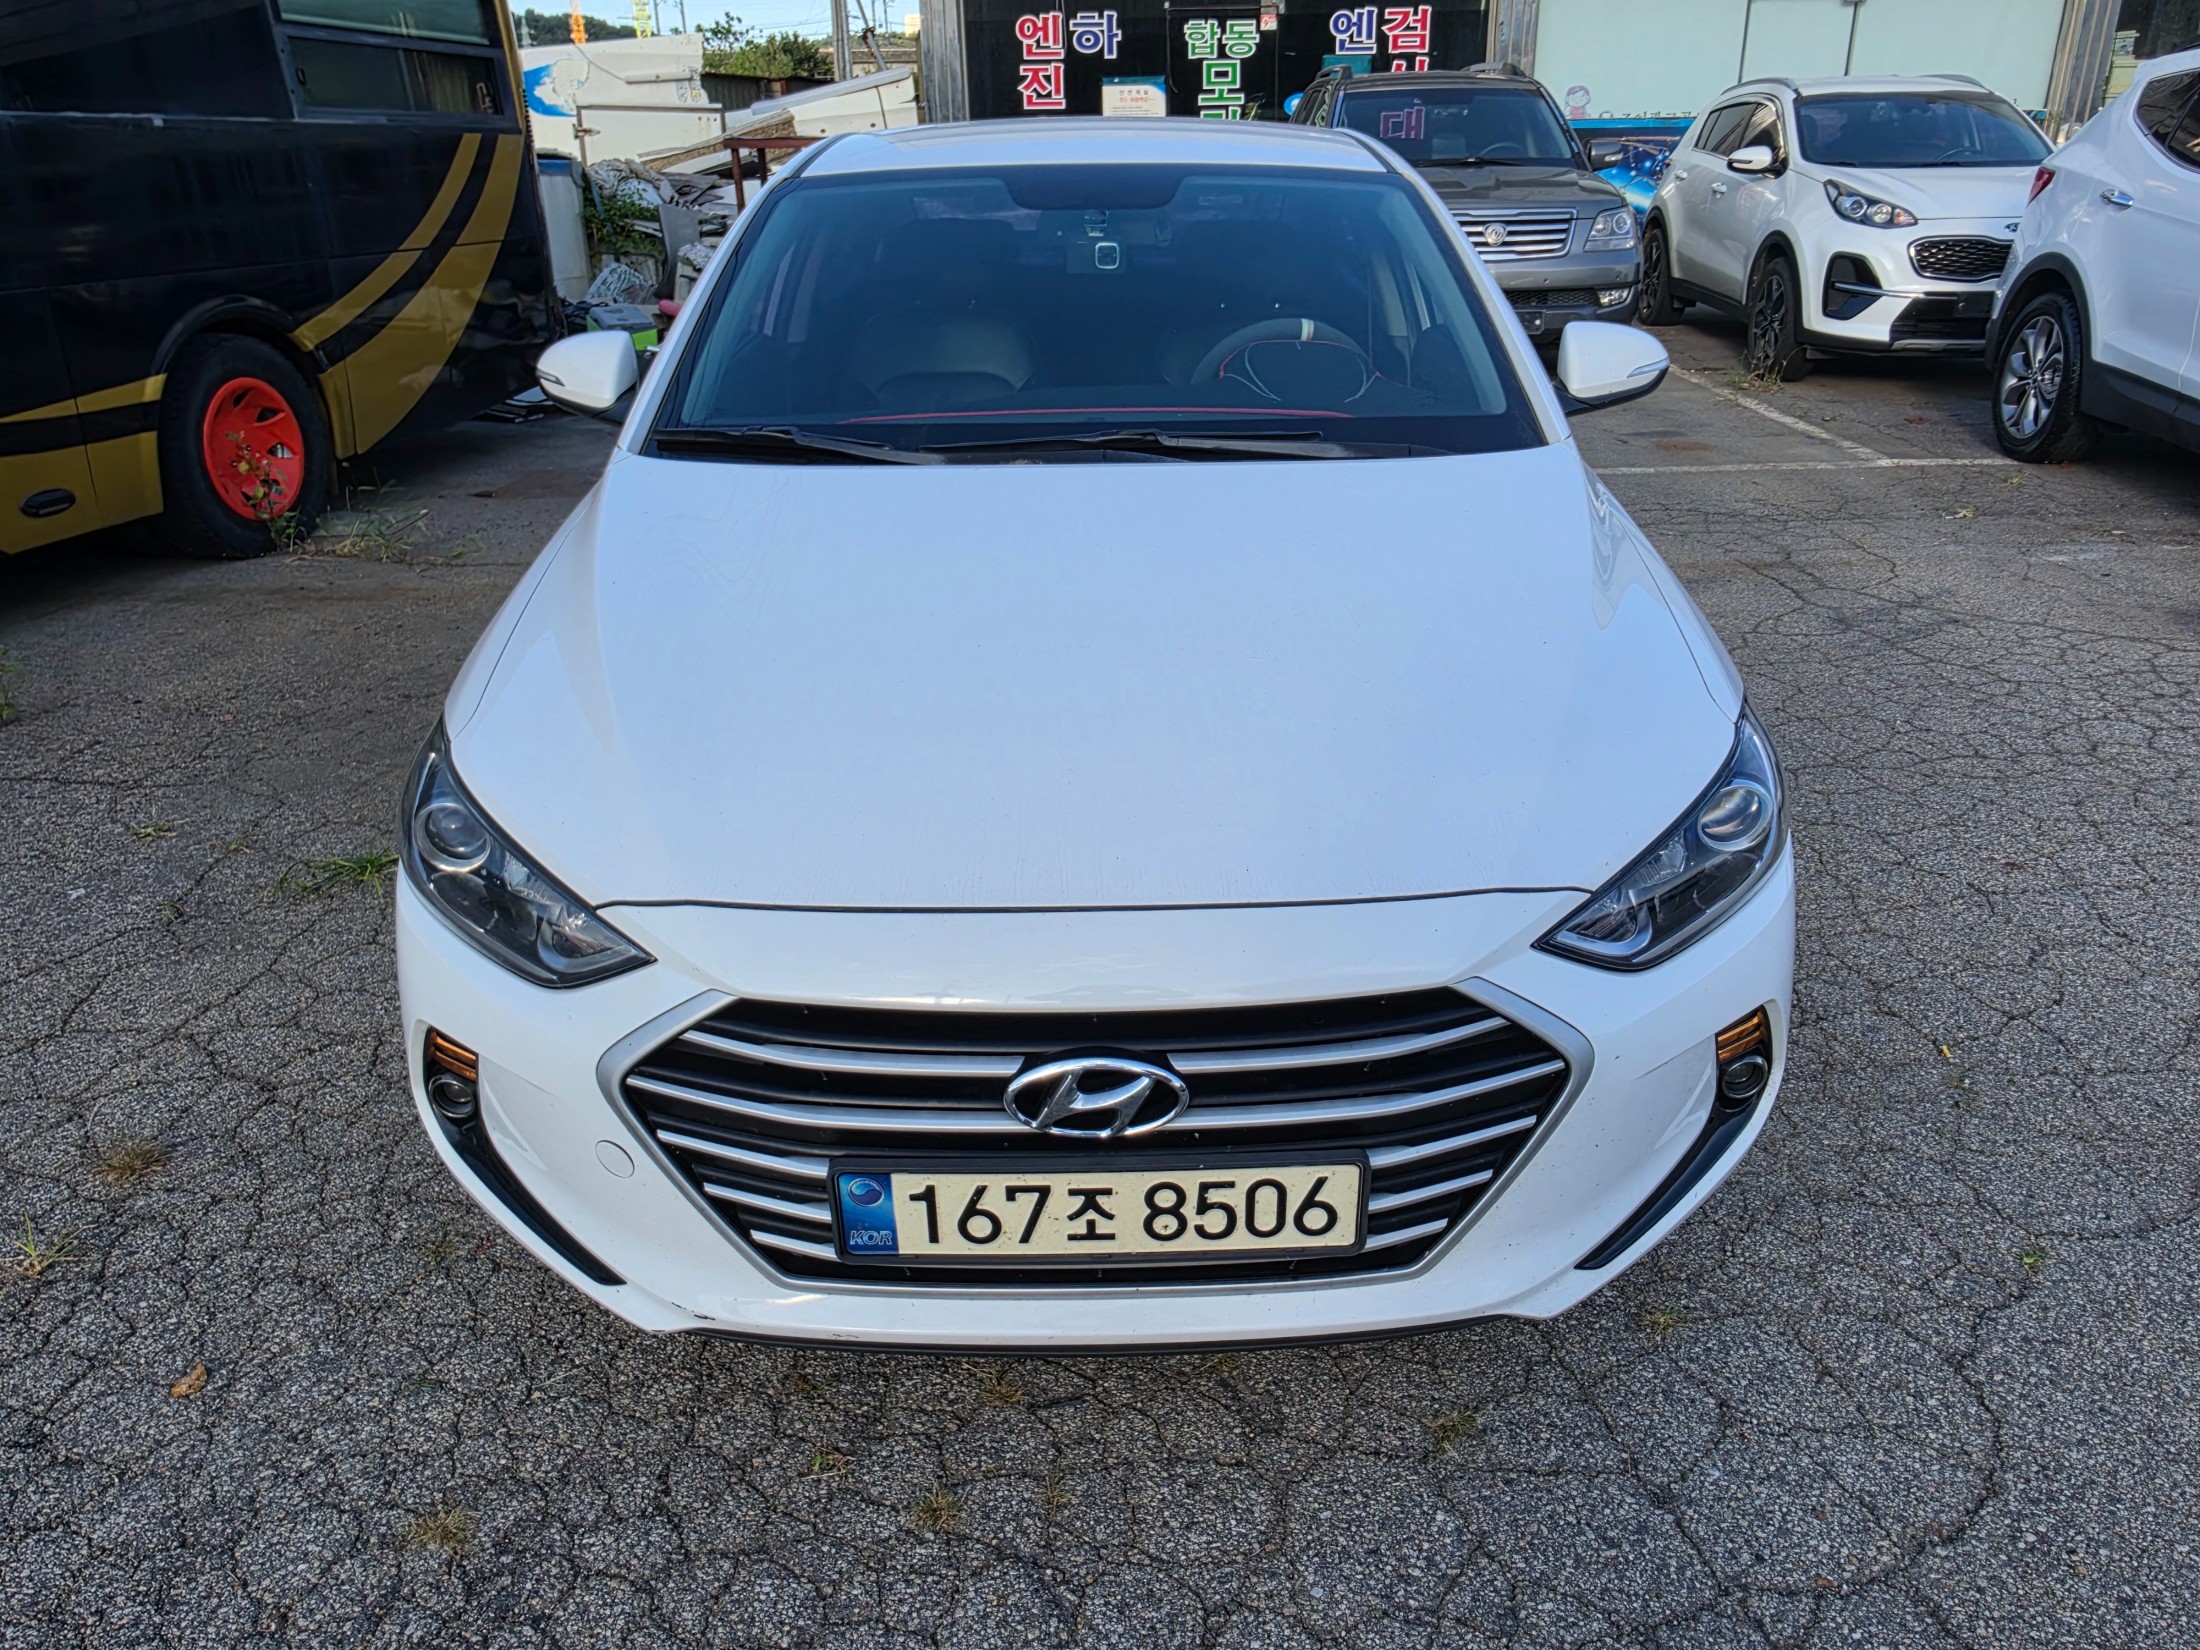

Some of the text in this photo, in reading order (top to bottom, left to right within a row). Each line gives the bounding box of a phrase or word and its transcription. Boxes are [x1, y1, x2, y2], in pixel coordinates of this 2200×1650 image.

[1016, 12, 1065, 109] 엔진
[1183, 18, 1260, 59] 합동
[909, 1176, 1338, 1244] 167조 8506
[850, 1230, 893, 1245] KOR
